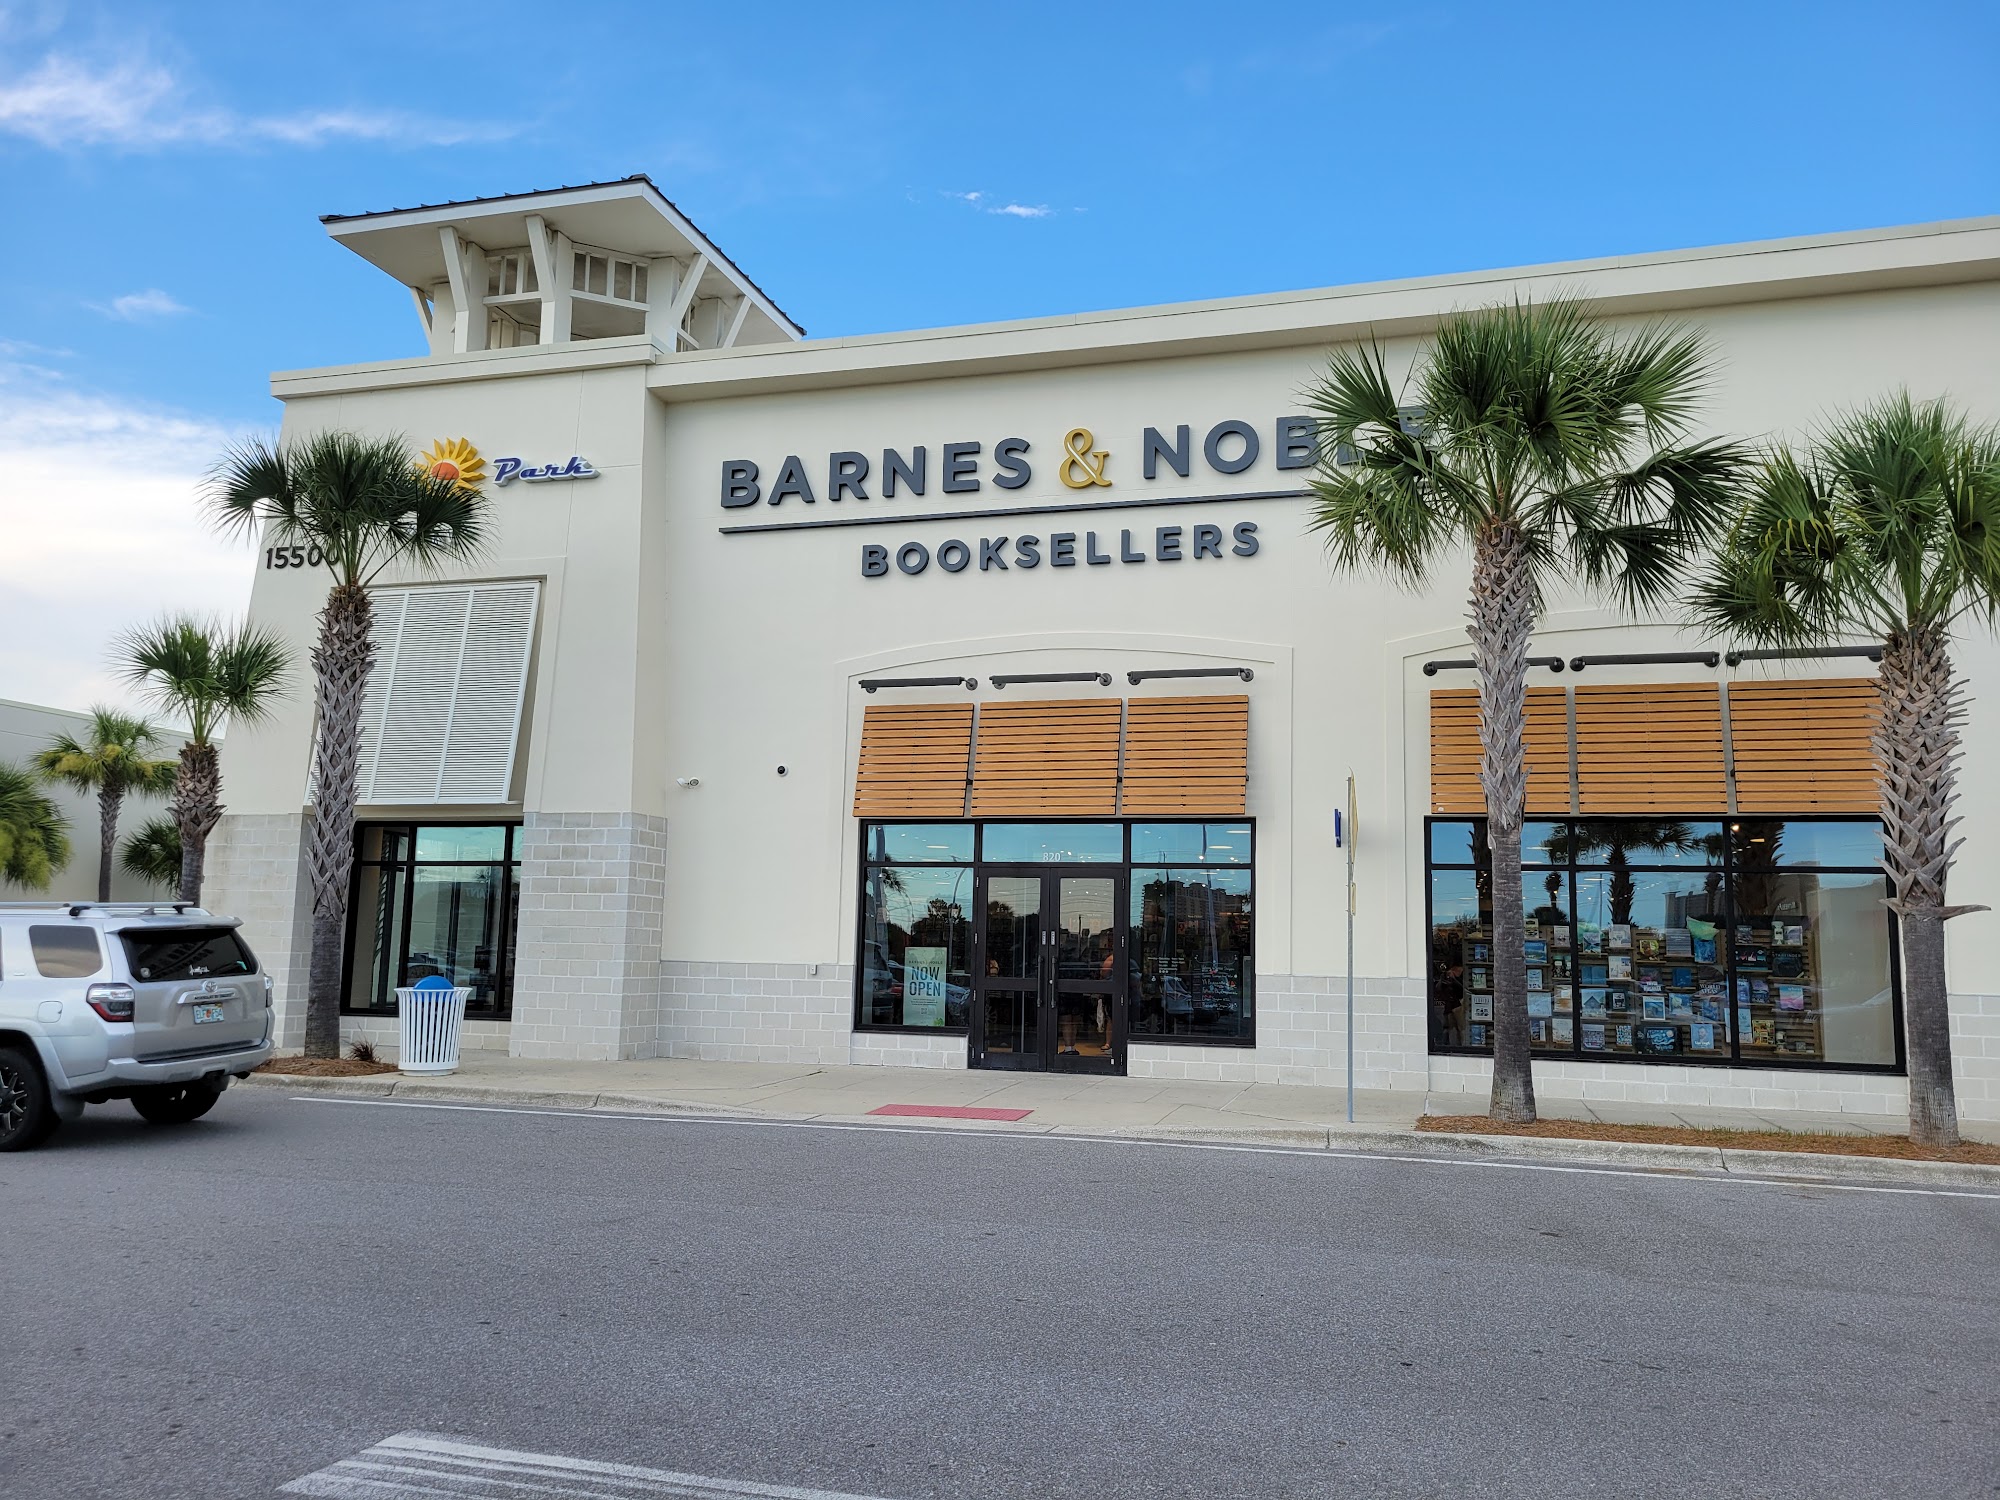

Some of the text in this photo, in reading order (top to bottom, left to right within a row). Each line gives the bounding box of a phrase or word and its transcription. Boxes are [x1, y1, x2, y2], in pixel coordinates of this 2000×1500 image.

[493, 455, 600, 487] Park
[720, 436, 1031, 509] BARNES
[1058, 427, 1112, 491] &
[861, 520, 1260, 578] BOOKSELLERS
[1043, 852, 1061, 862] 820
[911, 966, 940, 981] NOW
[909, 981, 941, 997] OPEN
